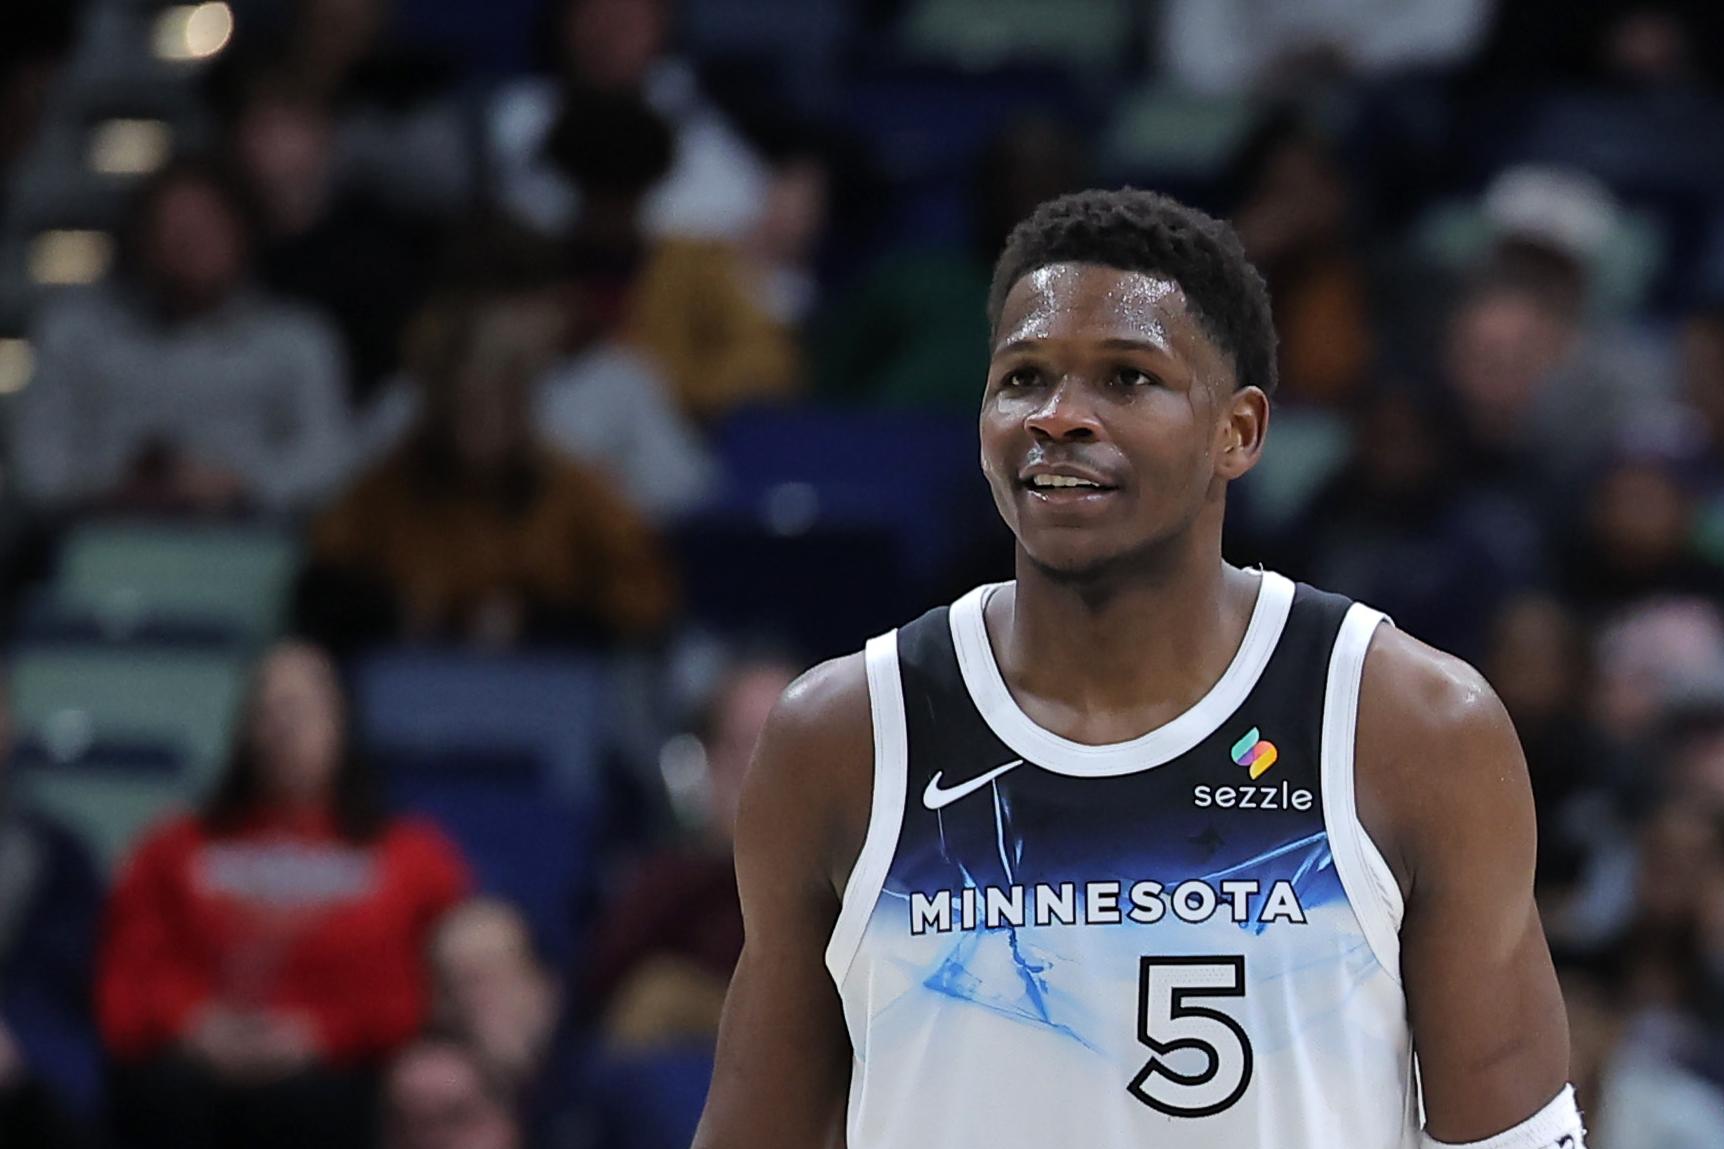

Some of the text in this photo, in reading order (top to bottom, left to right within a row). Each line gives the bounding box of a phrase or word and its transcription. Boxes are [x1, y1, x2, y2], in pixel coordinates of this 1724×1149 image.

[1193, 780, 1314, 811] sezzle
[909, 879, 1308, 936] MINNESOTA
[1126, 955, 1254, 1119] 5
